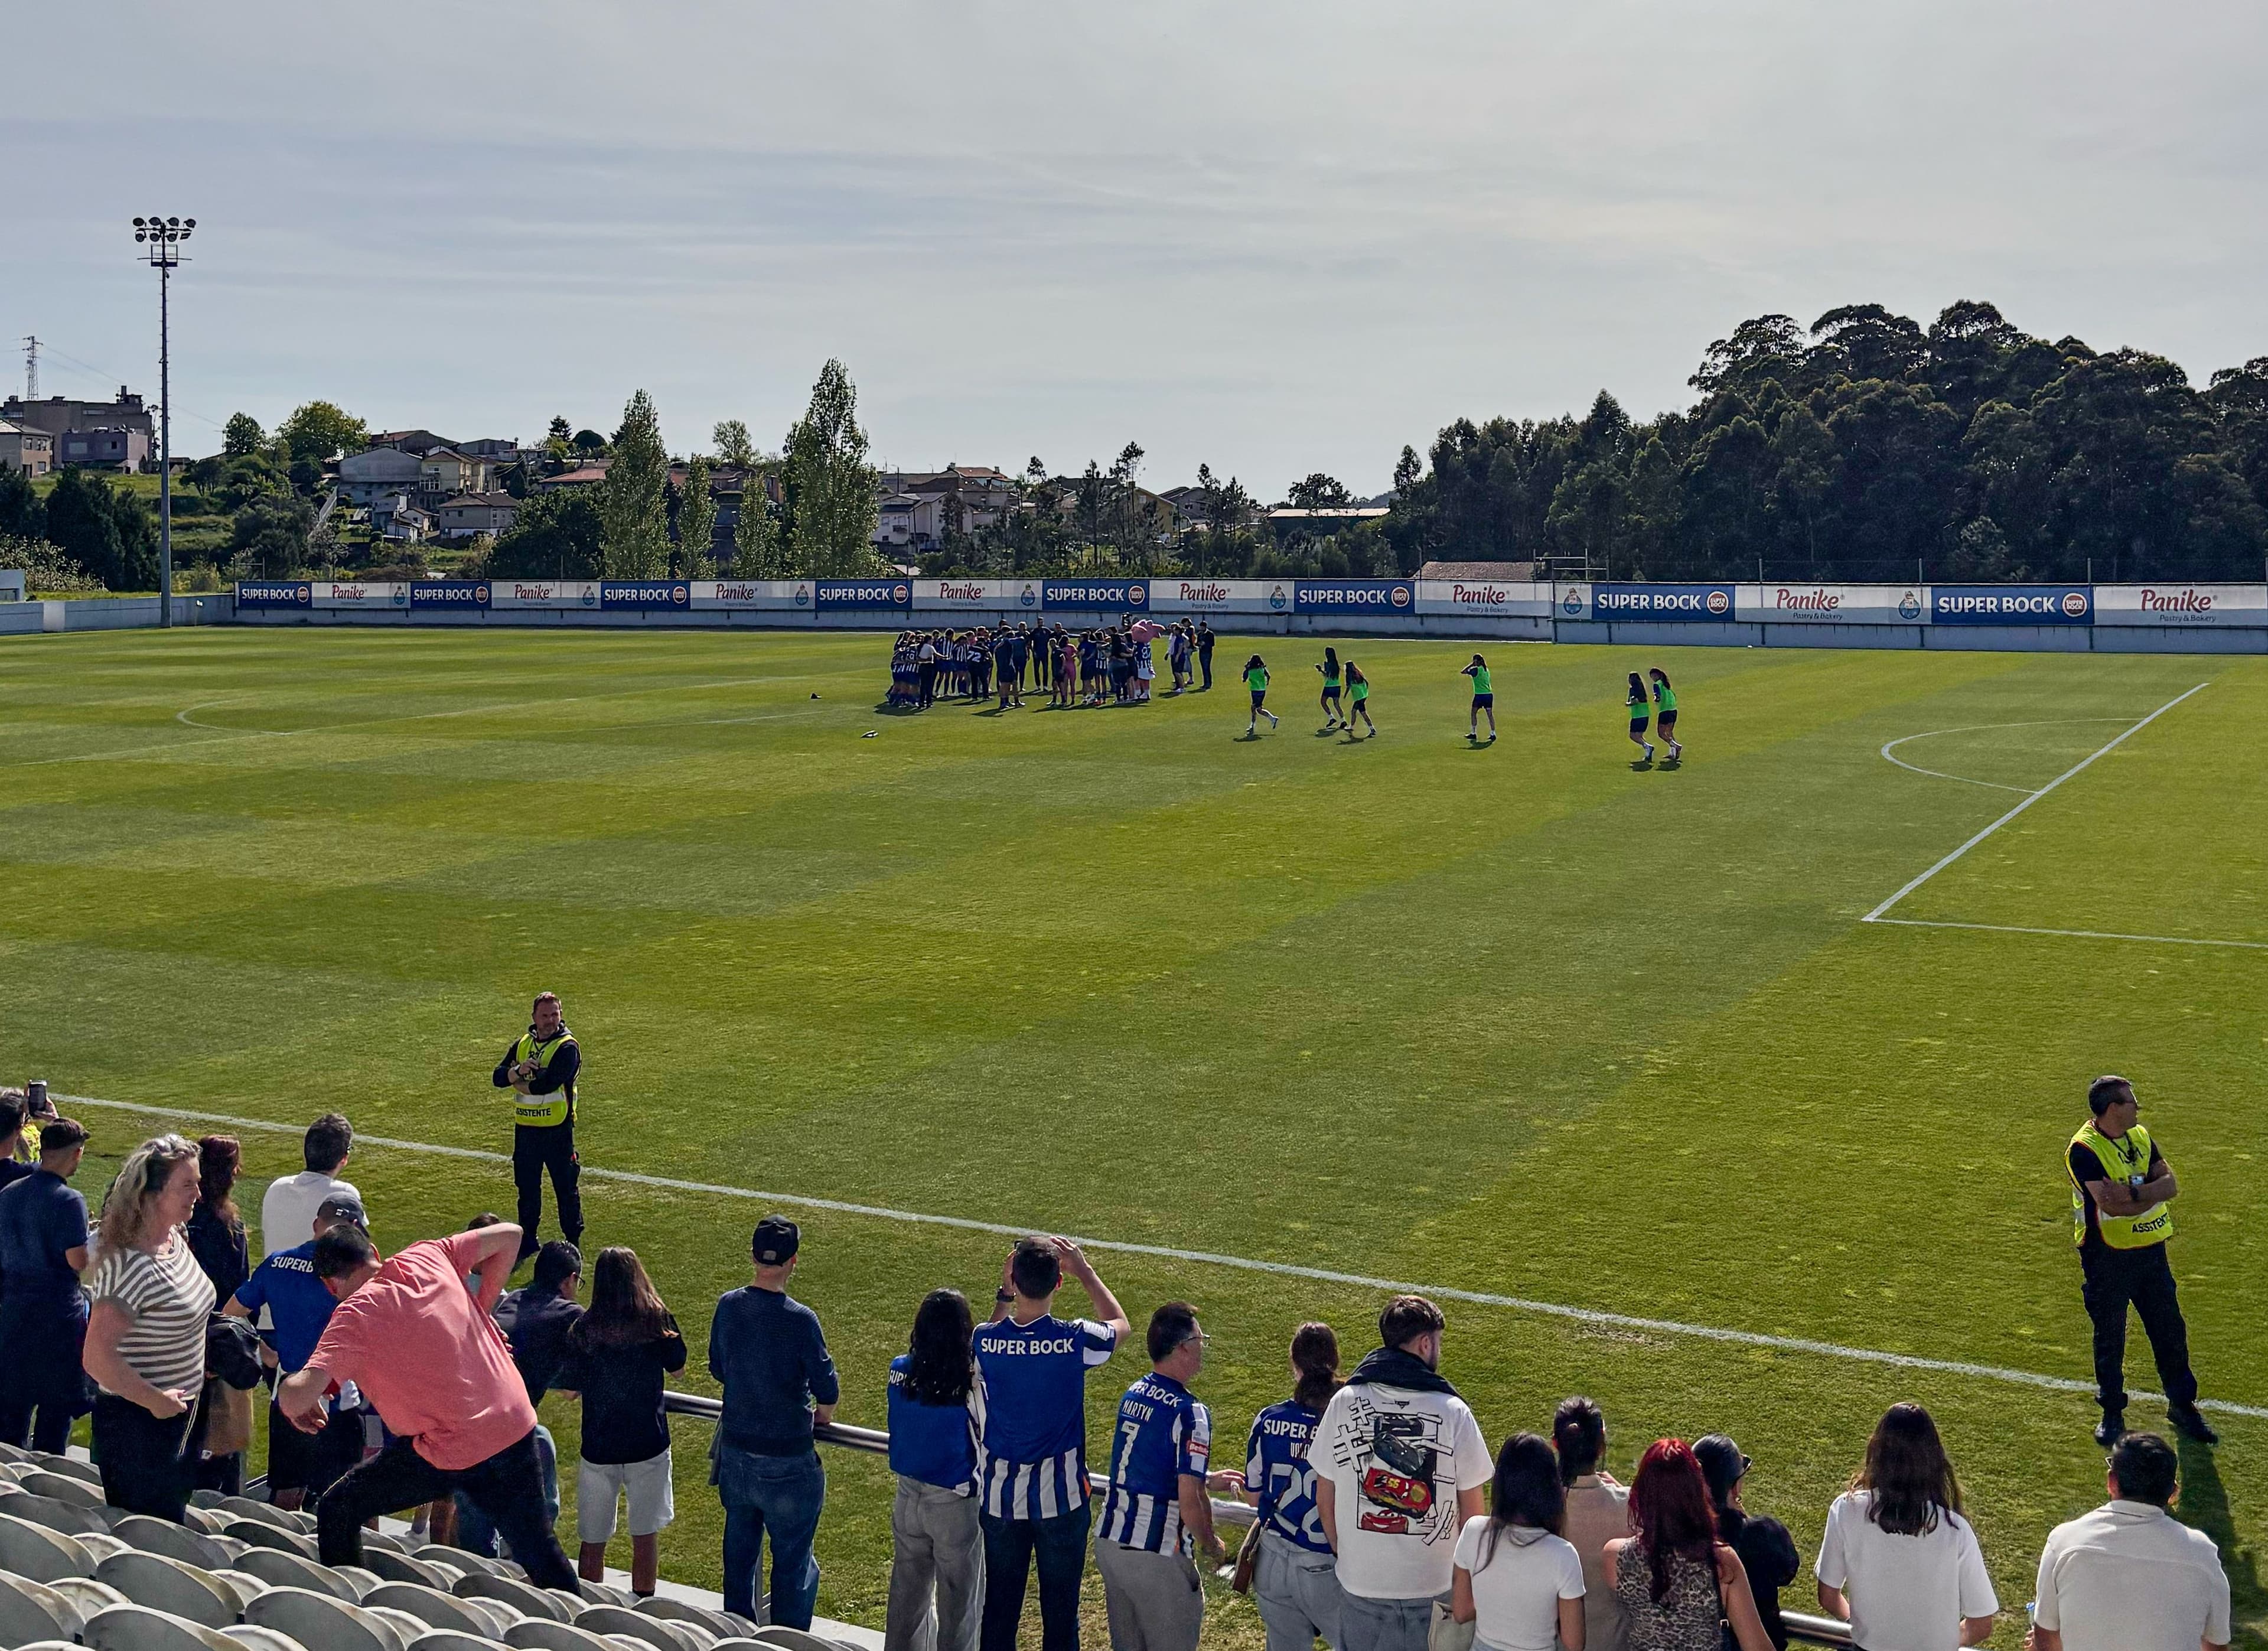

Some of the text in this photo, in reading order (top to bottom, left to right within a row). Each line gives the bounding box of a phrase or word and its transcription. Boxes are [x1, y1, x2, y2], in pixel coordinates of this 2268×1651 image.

[242, 588, 269, 600] SUPER
[270, 589, 295, 600] BOCK
[333, 585, 364, 600] Panike
[414, 589, 444, 600] SUPER
[445, 589, 472, 600] BOCK
[514, 584, 550, 600] Panike
[604, 589, 637, 601] SUPER
[640, 589, 669, 601] BOCK
[716, 584, 754, 600] Panike
[819, 588, 855, 600] SUPER
[858, 588, 889, 600] BOCK
[940, 582, 982, 600] Panike
[1047, 588, 1124, 601] SUPER BOCK
[1181, 583, 1226, 602] Panike
[1299, 590, 1386, 604] SUPER BOCK
[1453, 584, 1505, 605] Panike
[1598, 594, 1701, 610] SUPER BOCK
[1777, 588, 1839, 611] Panike
[1938, 597, 2056, 613] SUPER BOCK
[2141, 589, 2211, 613] Panike
[967, 650, 982, 662] 72
[980, 1337, 1075, 1355] SUPER BOCK
[1146, 1384, 1183, 1408] BOCK
[1122, 1399, 1154, 1423] MARTYN
[1263, 1419, 1308, 1439] SUPER
[1116, 1420, 1140, 1485] 7
